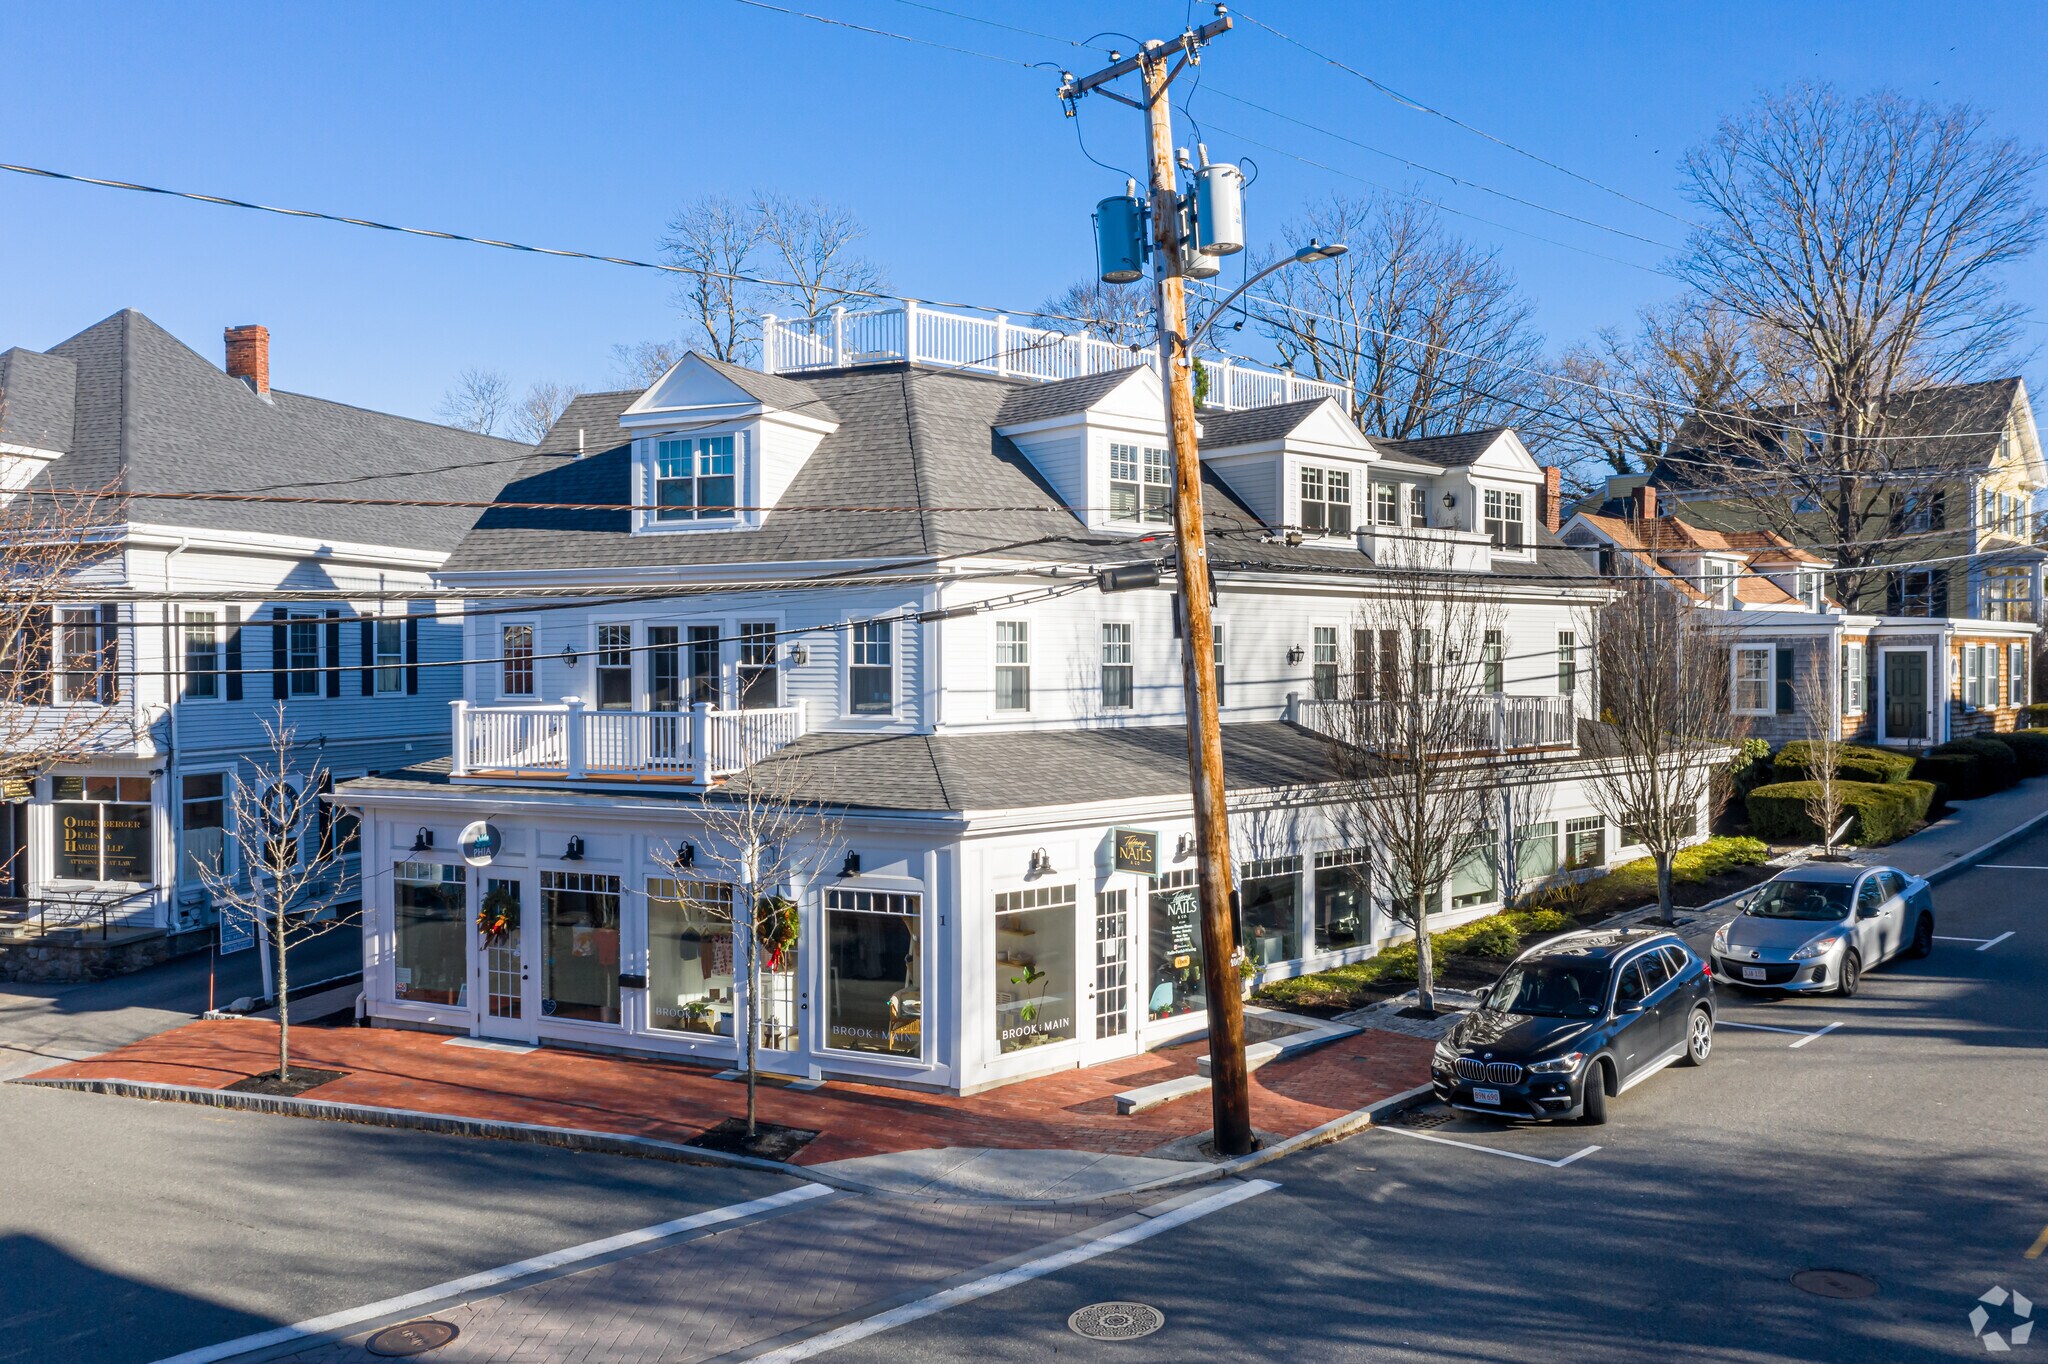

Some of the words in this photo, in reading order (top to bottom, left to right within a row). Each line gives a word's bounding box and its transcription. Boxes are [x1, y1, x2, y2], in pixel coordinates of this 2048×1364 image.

[64, 841, 103, 852] HARRI
[473, 848, 491, 857] PHIA
[1120, 846, 1152, 862] NAILS
[1168, 900, 1197, 916] NAILS
[940, 915, 946, 926] 1
[656, 1007, 691, 1019] BROOK
[833, 1026, 873, 1039] BROOK
[882, 1031, 912, 1042] MAIN
[1002, 1024, 1037, 1040] BROOK
[1044, 1017, 1070, 1031] MAIN
